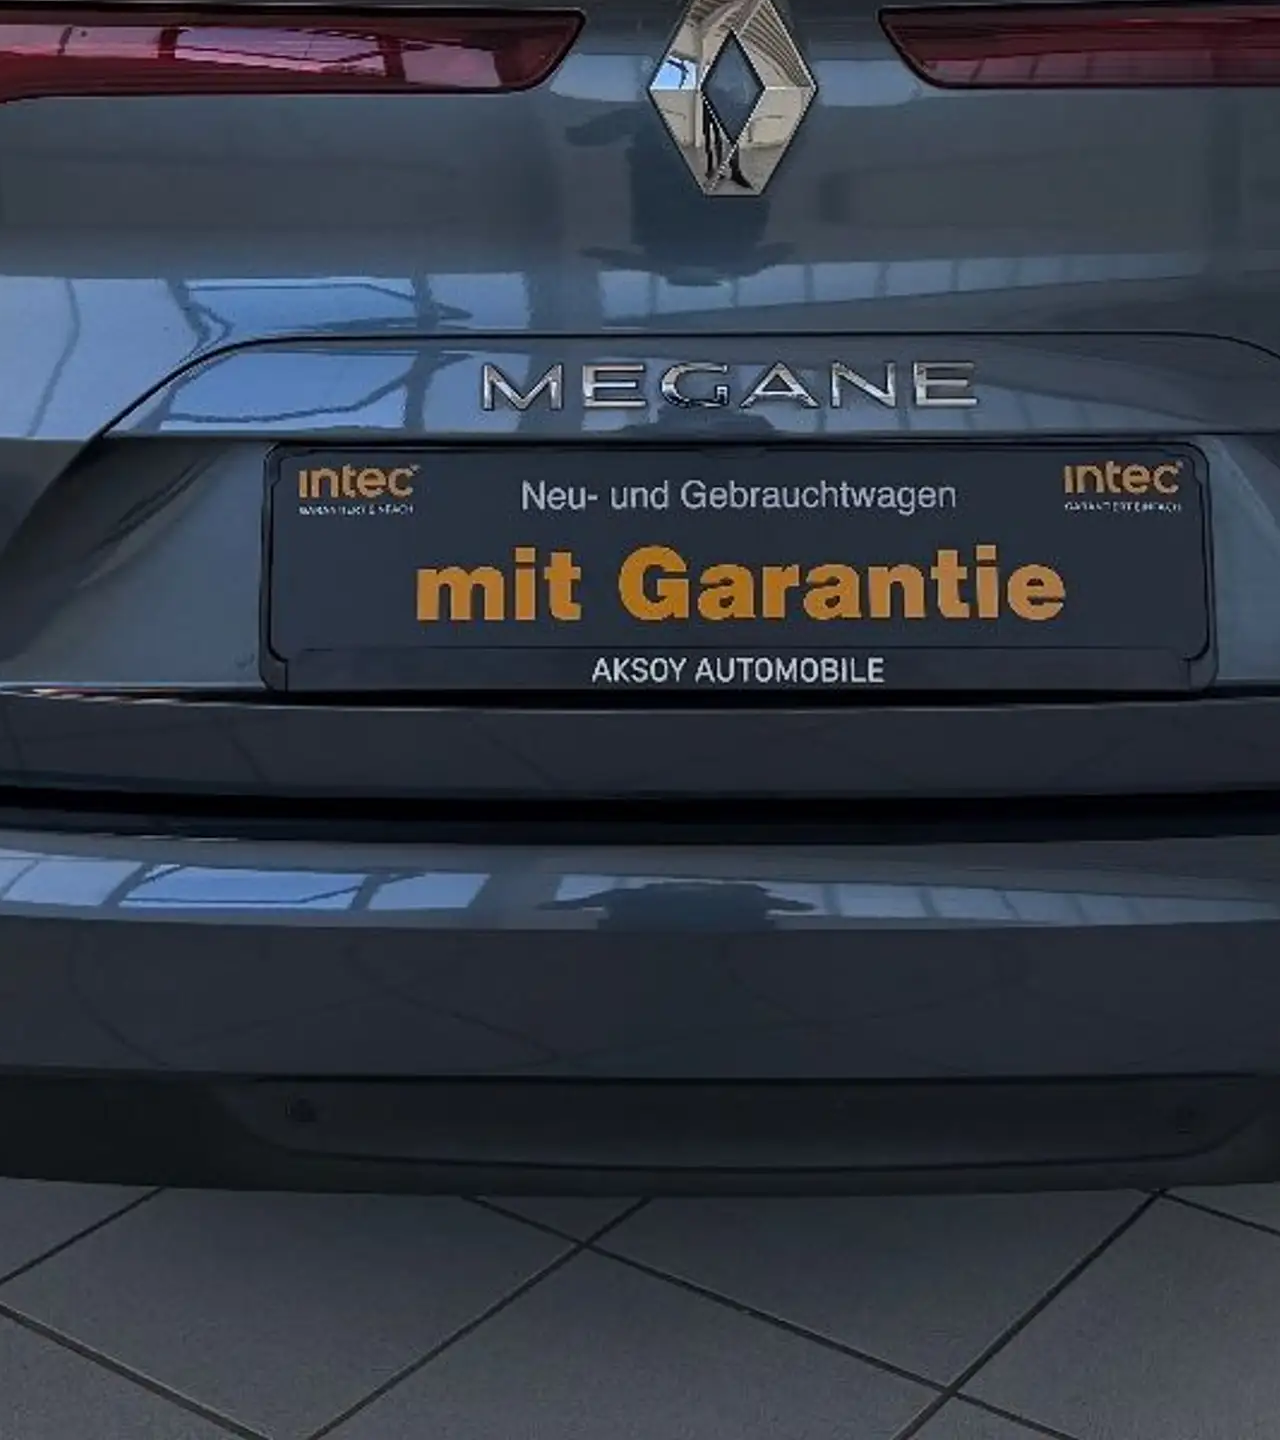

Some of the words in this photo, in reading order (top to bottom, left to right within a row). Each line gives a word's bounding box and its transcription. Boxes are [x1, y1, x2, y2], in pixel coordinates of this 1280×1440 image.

[483, 362, 978, 411] MEGANE
[521, 480, 598, 510] Neu-
[610, 480, 670, 510] und
[681, 479, 956, 516] Gebrauchtwagen
[416, 547, 583, 621] mit
[619, 544, 1066, 622] Garantie
[591, 657, 687, 684] AKSOY
[695, 657, 885, 684] AUTOMOBILE
